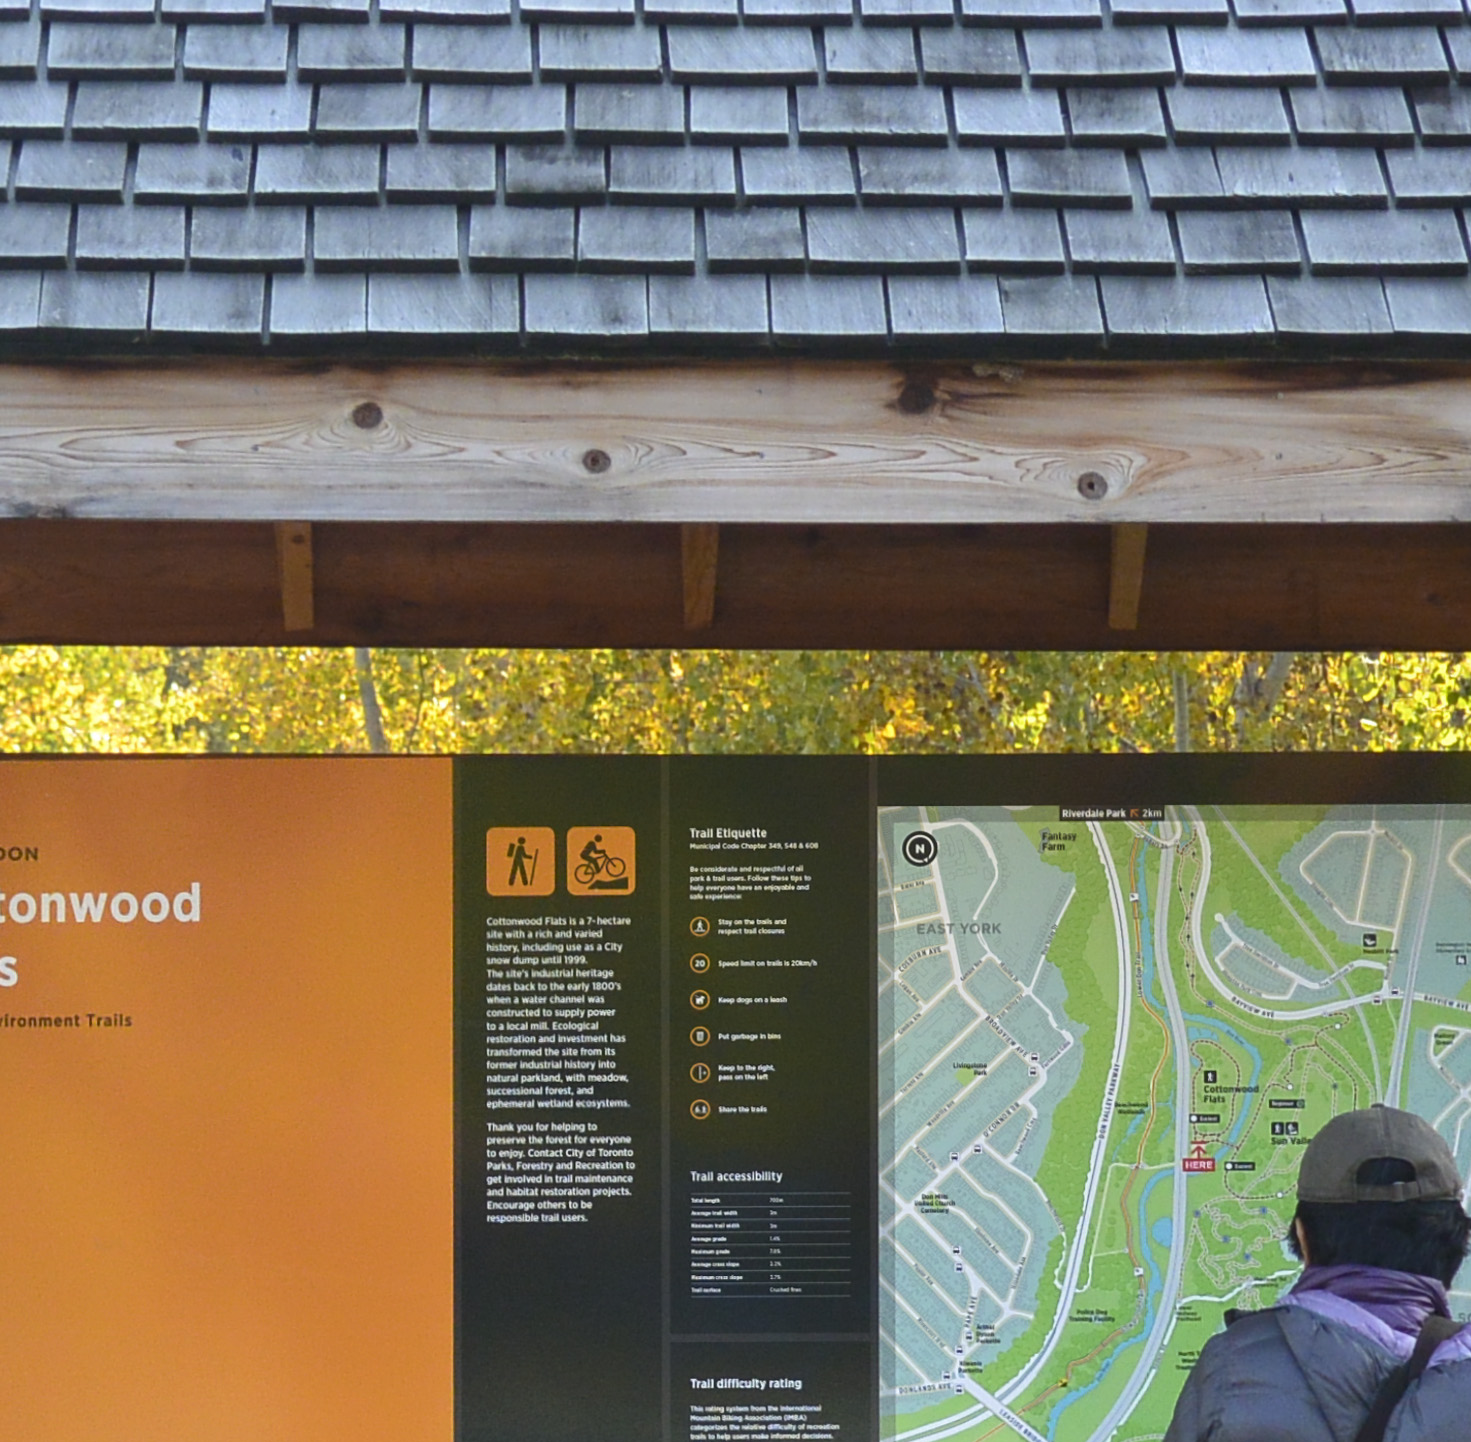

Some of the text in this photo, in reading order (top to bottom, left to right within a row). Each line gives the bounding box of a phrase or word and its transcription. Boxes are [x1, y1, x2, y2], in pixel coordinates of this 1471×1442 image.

[1062, 808, 1163, 818] Riverdale Park 2km
[689, 828, 768, 840] Trail Etiquette
[1042, 831, 1077, 842] Fantasy
[915, 844, 925, 854] N
[1042, 842, 1066, 851] Farm
[486, 917, 543, 926] Cottonwood
[544, 917, 567, 925] Flats
[569, 917, 577, 925] is
[586, 916, 631, 925] 7-hectare
[486, 929, 603, 939] site with a rich and varied
[916, 923, 1001, 935] EAST YORK
[486, 943, 519, 953] history,
[522, 943, 564, 953] including
[604, 942, 623, 953] City
[486, 955, 588, 965] snow dump until 1999.
[487, 968, 614, 979] The site's industrial heritage
[486, 982, 622, 992] dates back to the early 1800's
[486, 996, 511, 1004] when
[513, 996, 519, 1004] a
[521, 995, 547, 1004] water
[549, 995, 585, 1004] channel
[486, 1008, 616, 1018] constructed to supply power
[86, 1013, 133, 1028] Trails
[486, 1021, 599, 1032] to a local mill. Ecological
[486, 1033, 626, 1044] restoration and investment has
[486, 1047, 616, 1057] transformed the site from its
[486, 1060, 616, 1070] former industrial history into
[486, 1073, 629, 1084] natural parkland, with meadow,
[486, 1086, 594, 1096] successional forest, and
[1203, 1085, 1259, 1093] Cottonwood
[486, 1098, 630, 1110] ephemeral wetland ecosystems.
[1203, 1095, 1226, 1103] Flats
[486, 1122, 598, 1133] Thank you for helping to
[486, 1135, 632, 1146] preserve the forest for everyone
[1271, 1137, 1286, 1145] Sun
[1185, 1161, 1214, 1169] HERE
[690, 1171, 783, 1183] Trail accessibility
[690, 1378, 802, 1390] Trail difficulty rating
